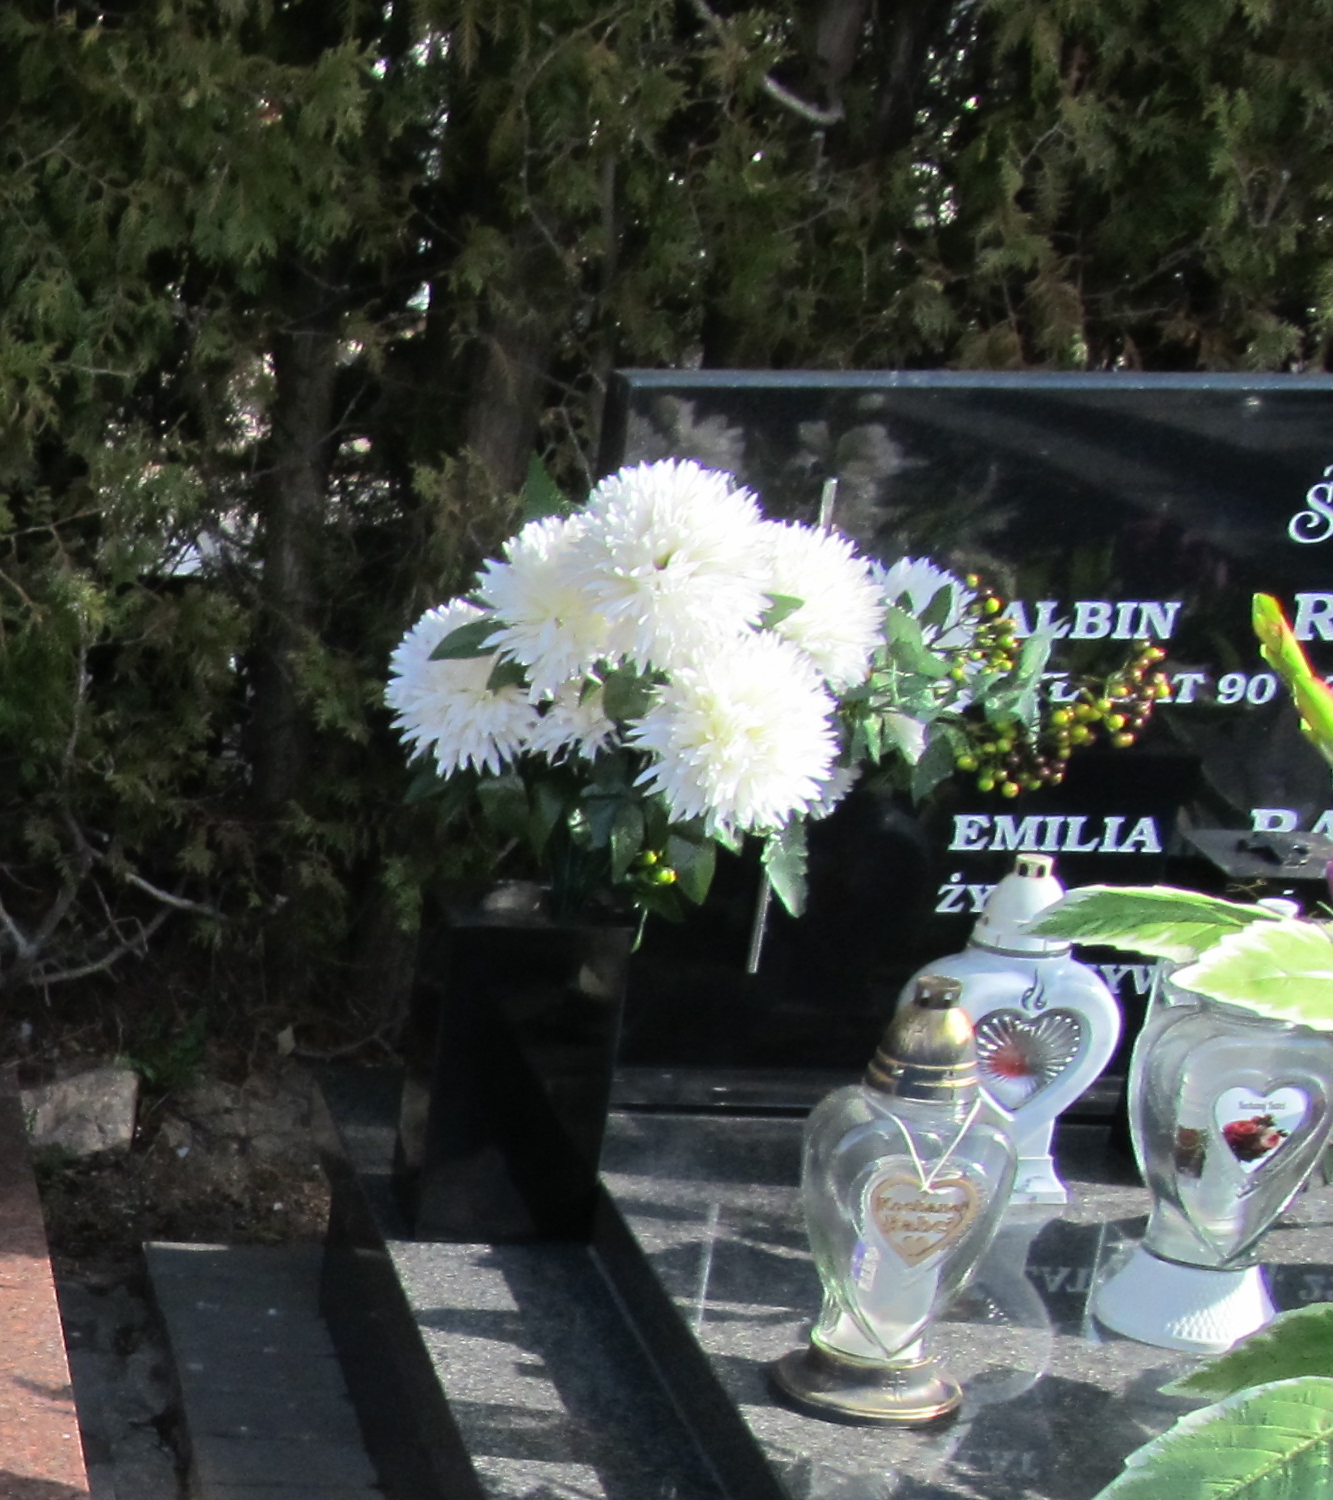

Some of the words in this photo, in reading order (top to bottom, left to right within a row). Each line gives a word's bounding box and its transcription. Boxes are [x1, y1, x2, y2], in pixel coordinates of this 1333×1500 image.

[999, 600, 1182, 640] ALBIN
[1217, 671, 1279, 705] 90
[947, 814, 1163, 854] EMILIA
